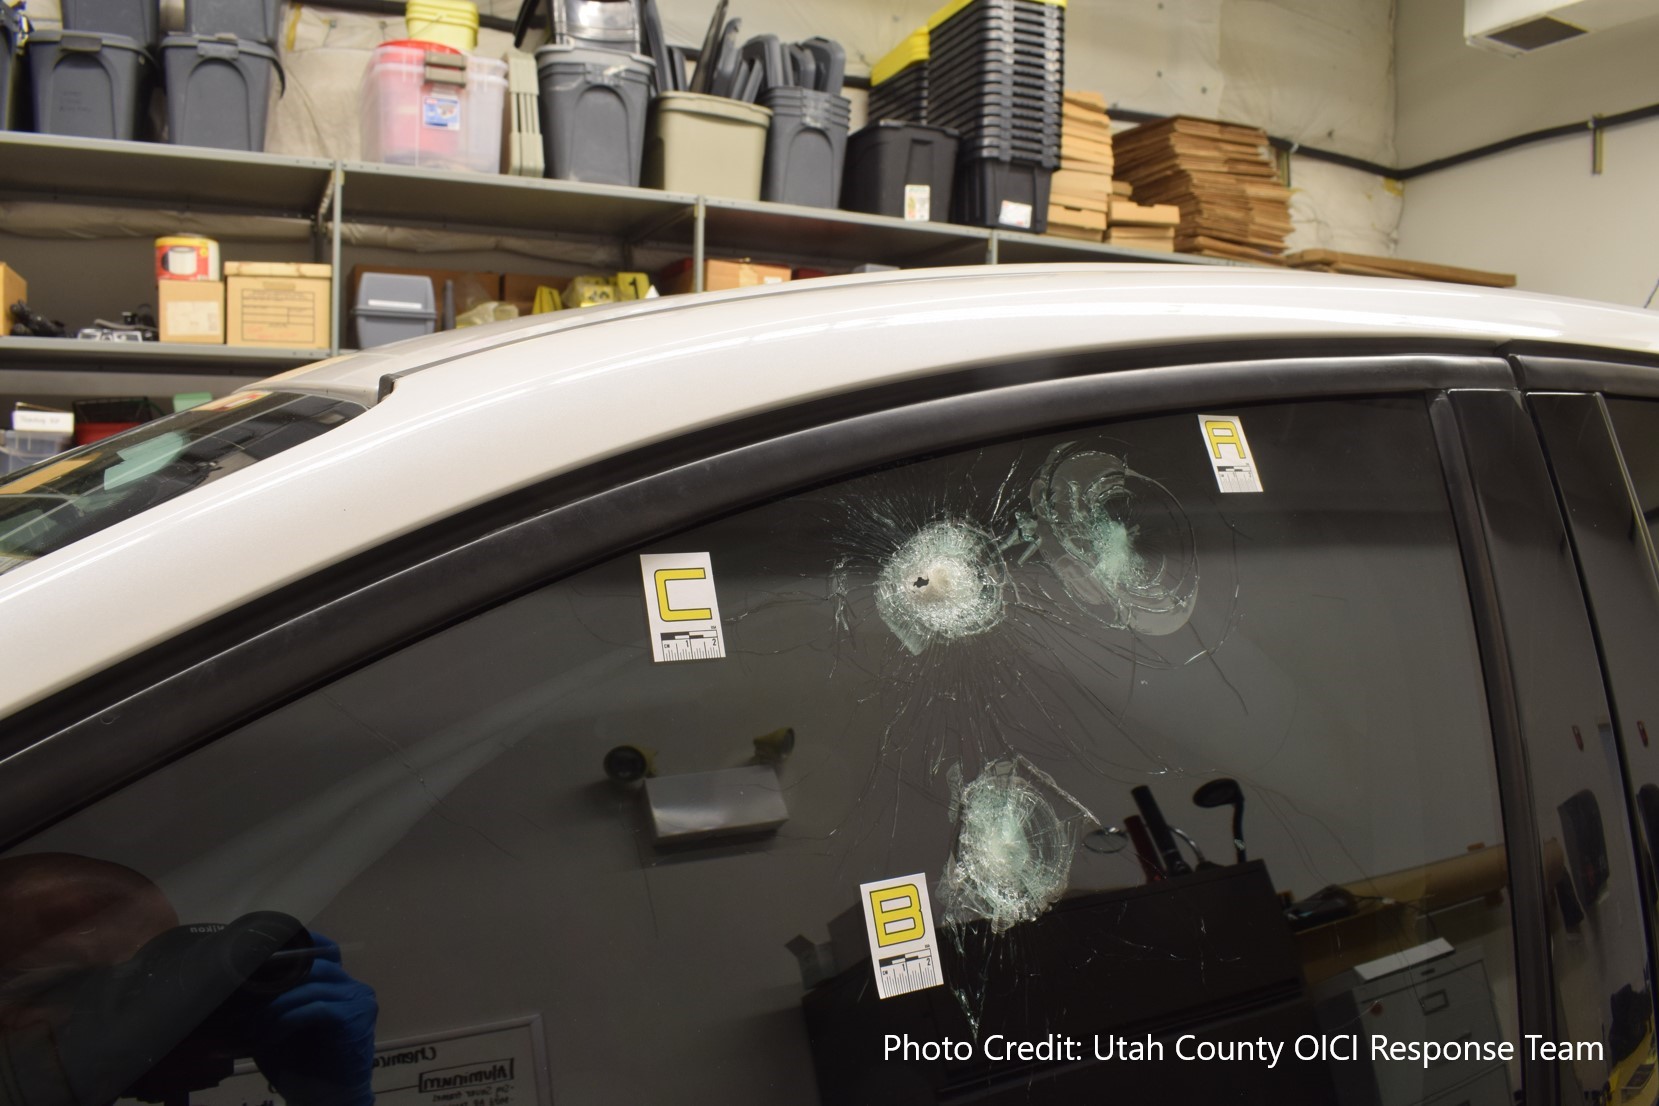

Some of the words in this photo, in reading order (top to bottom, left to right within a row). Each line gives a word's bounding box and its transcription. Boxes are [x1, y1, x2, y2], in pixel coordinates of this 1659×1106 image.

[1205, 420, 1246, 459] A
[654, 568, 712, 621] C
[712, 638, 717, 646] 2
[870, 884, 925, 947] B
[926, 957, 931, 966] 2
